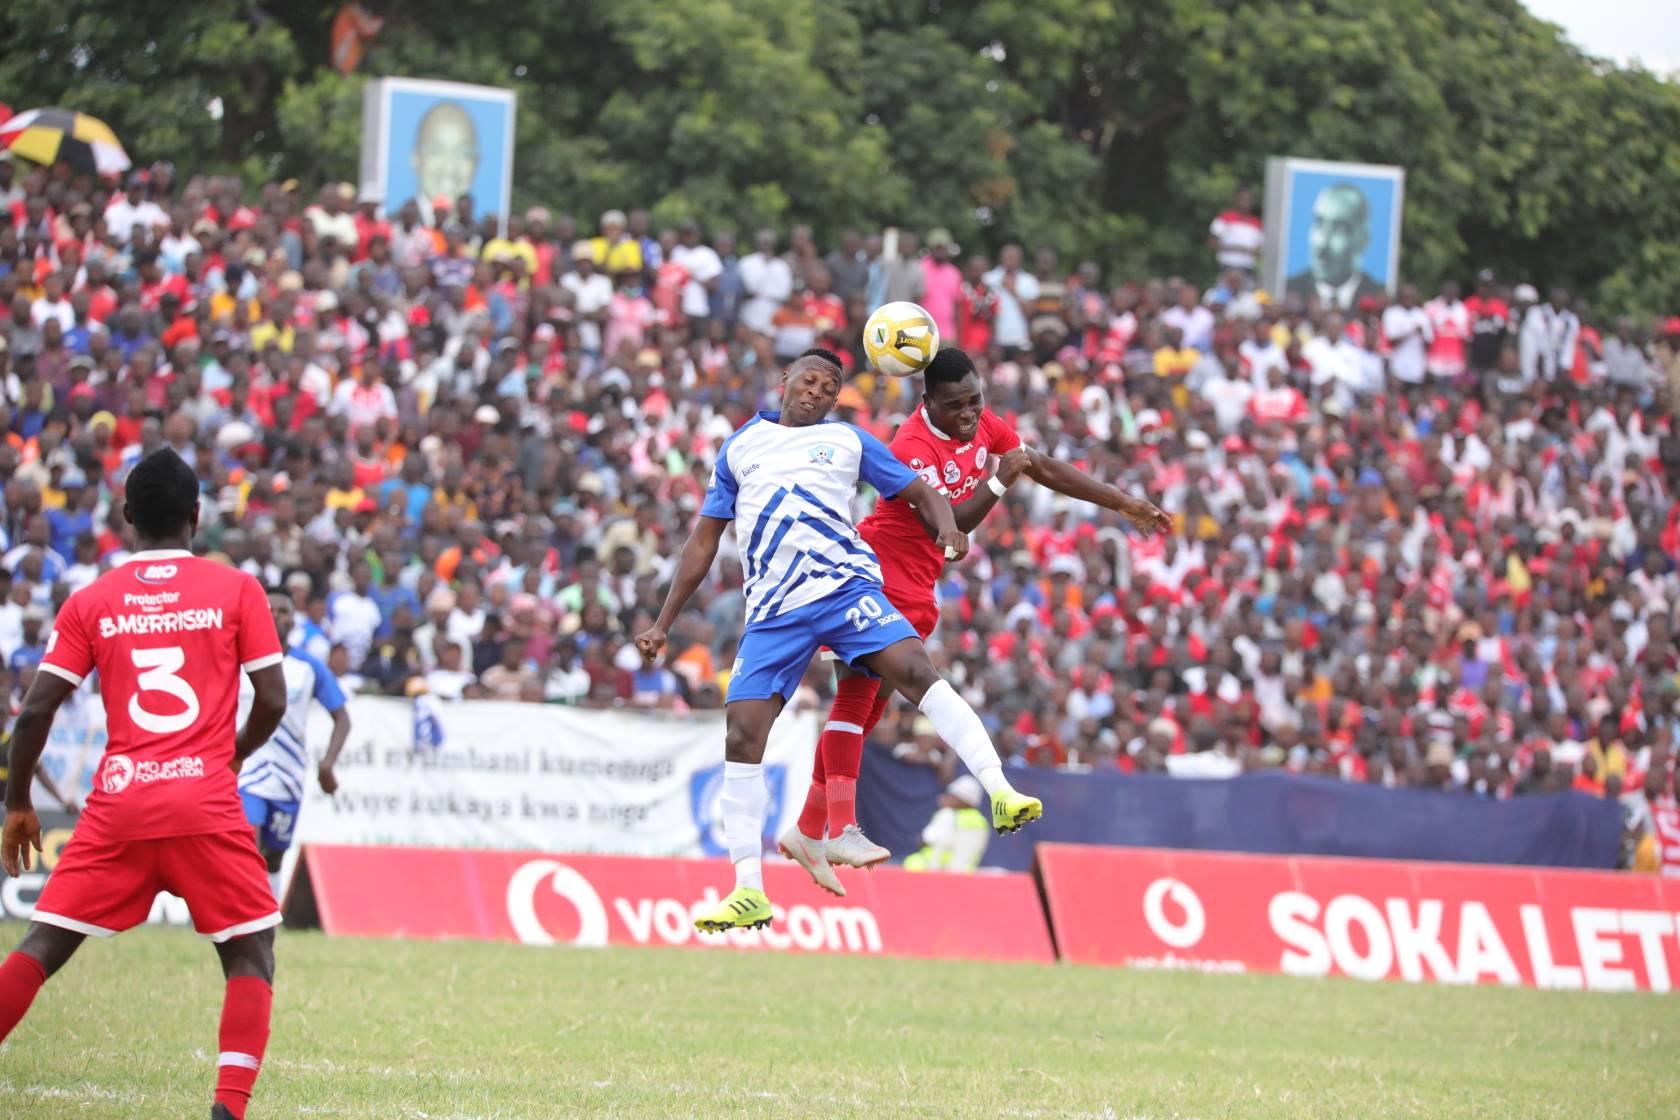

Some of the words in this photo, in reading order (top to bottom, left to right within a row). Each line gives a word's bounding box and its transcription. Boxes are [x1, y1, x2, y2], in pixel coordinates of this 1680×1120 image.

[124, 591, 180, 606] Protector
[845, 595, 883, 633] 20
[128, 646, 200, 734] 3
[134, 767, 205, 783] FOUNDATION
[135, 760, 160, 775] MO
[1268, 891, 1521, 985] SOKA
[1518, 904, 1680, 993] LET
